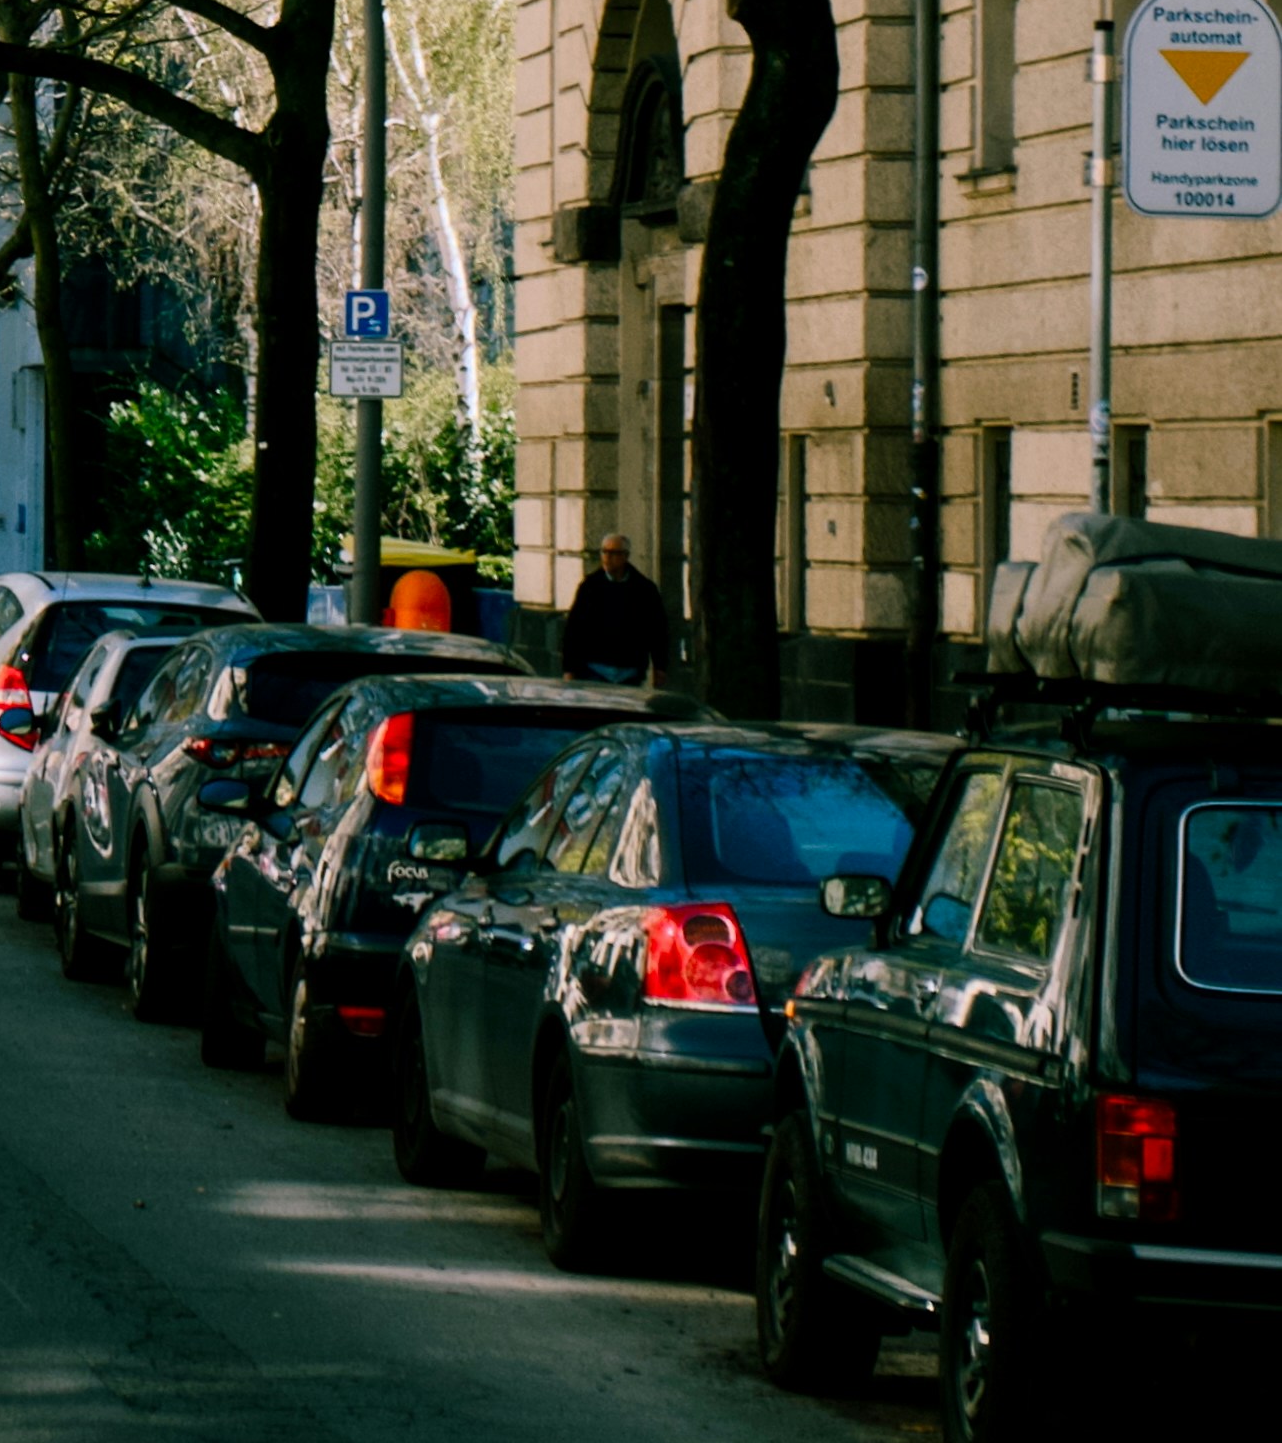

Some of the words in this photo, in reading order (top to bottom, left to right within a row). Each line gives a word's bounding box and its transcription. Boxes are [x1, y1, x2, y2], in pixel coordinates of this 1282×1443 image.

[1154, 7, 1259, 24] Parkschein-
[1171, 31, 1242, 45] automat
[1156, 114, 1255, 131] Parkschein
[1162, 136, 1195, 151] hier
[1202, 136, 1249, 152] lösen
[1151, 171, 1258, 187] Handyparkzone
[1175, 192, 1235, 206] 100014
[352, 296, 376, 331] P
